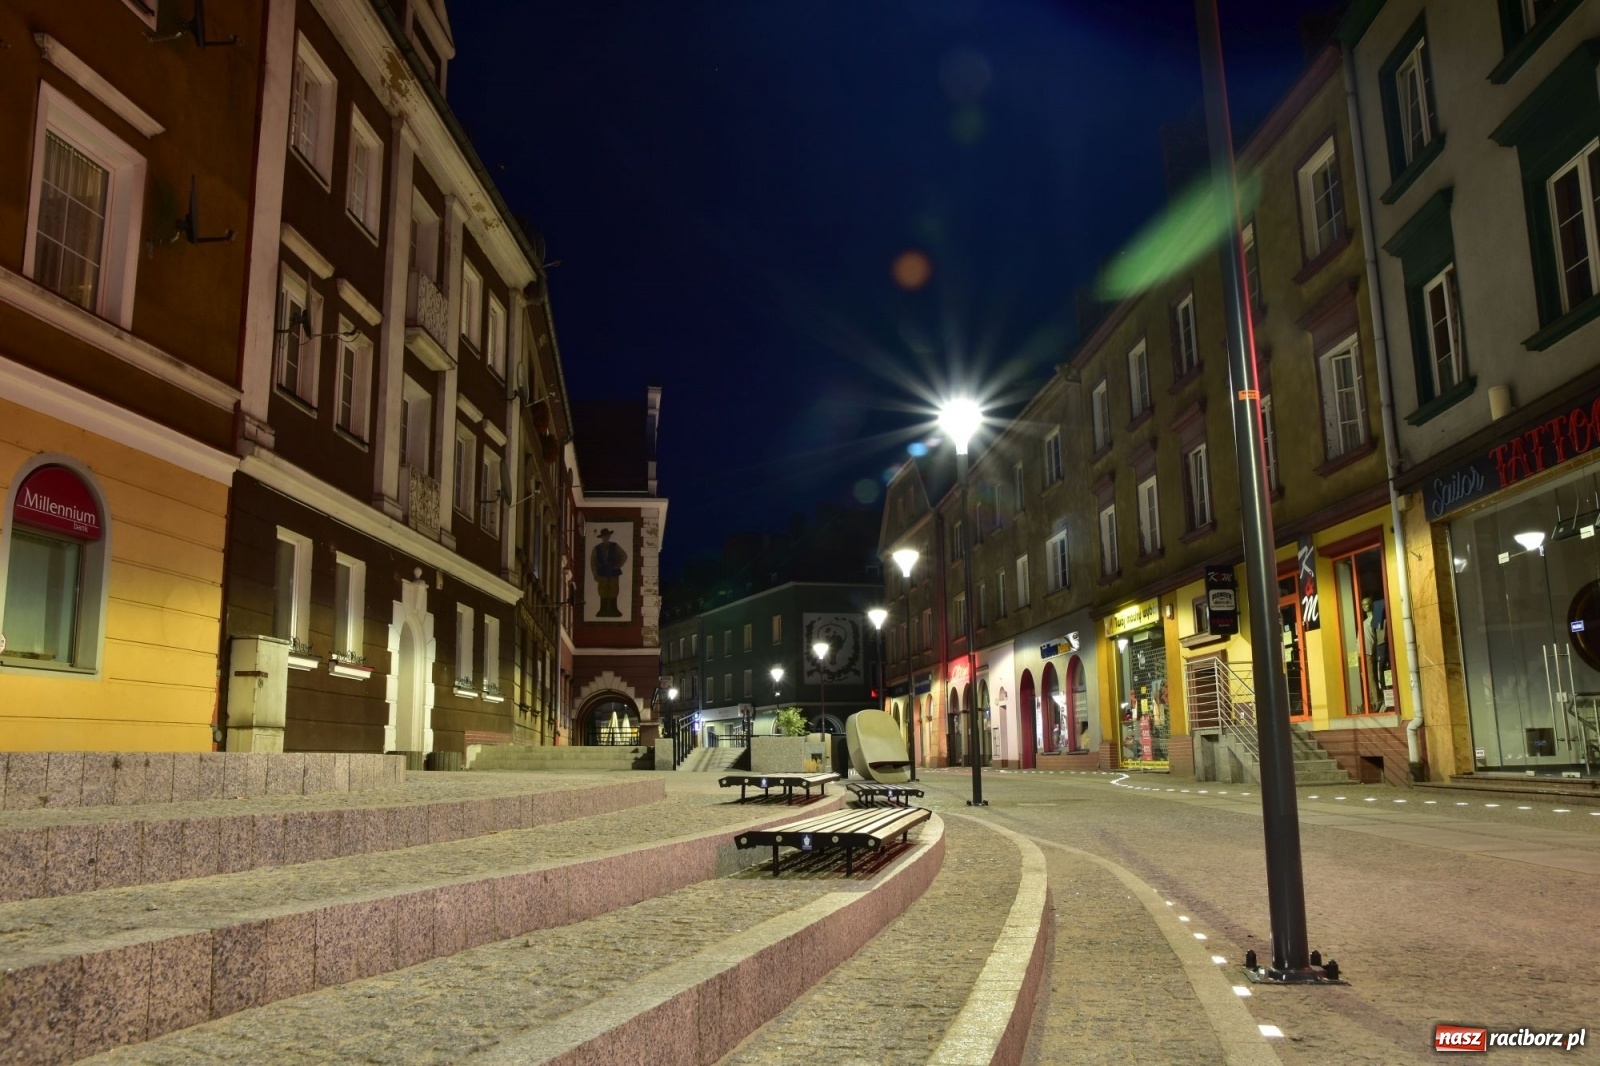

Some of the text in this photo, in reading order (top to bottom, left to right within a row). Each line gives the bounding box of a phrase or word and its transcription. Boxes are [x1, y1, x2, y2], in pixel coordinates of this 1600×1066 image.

[24, 487, 96, 525] Millennium
[1432, 465, 1485, 516] Sailor
[73, 521, 89, 533] bank
